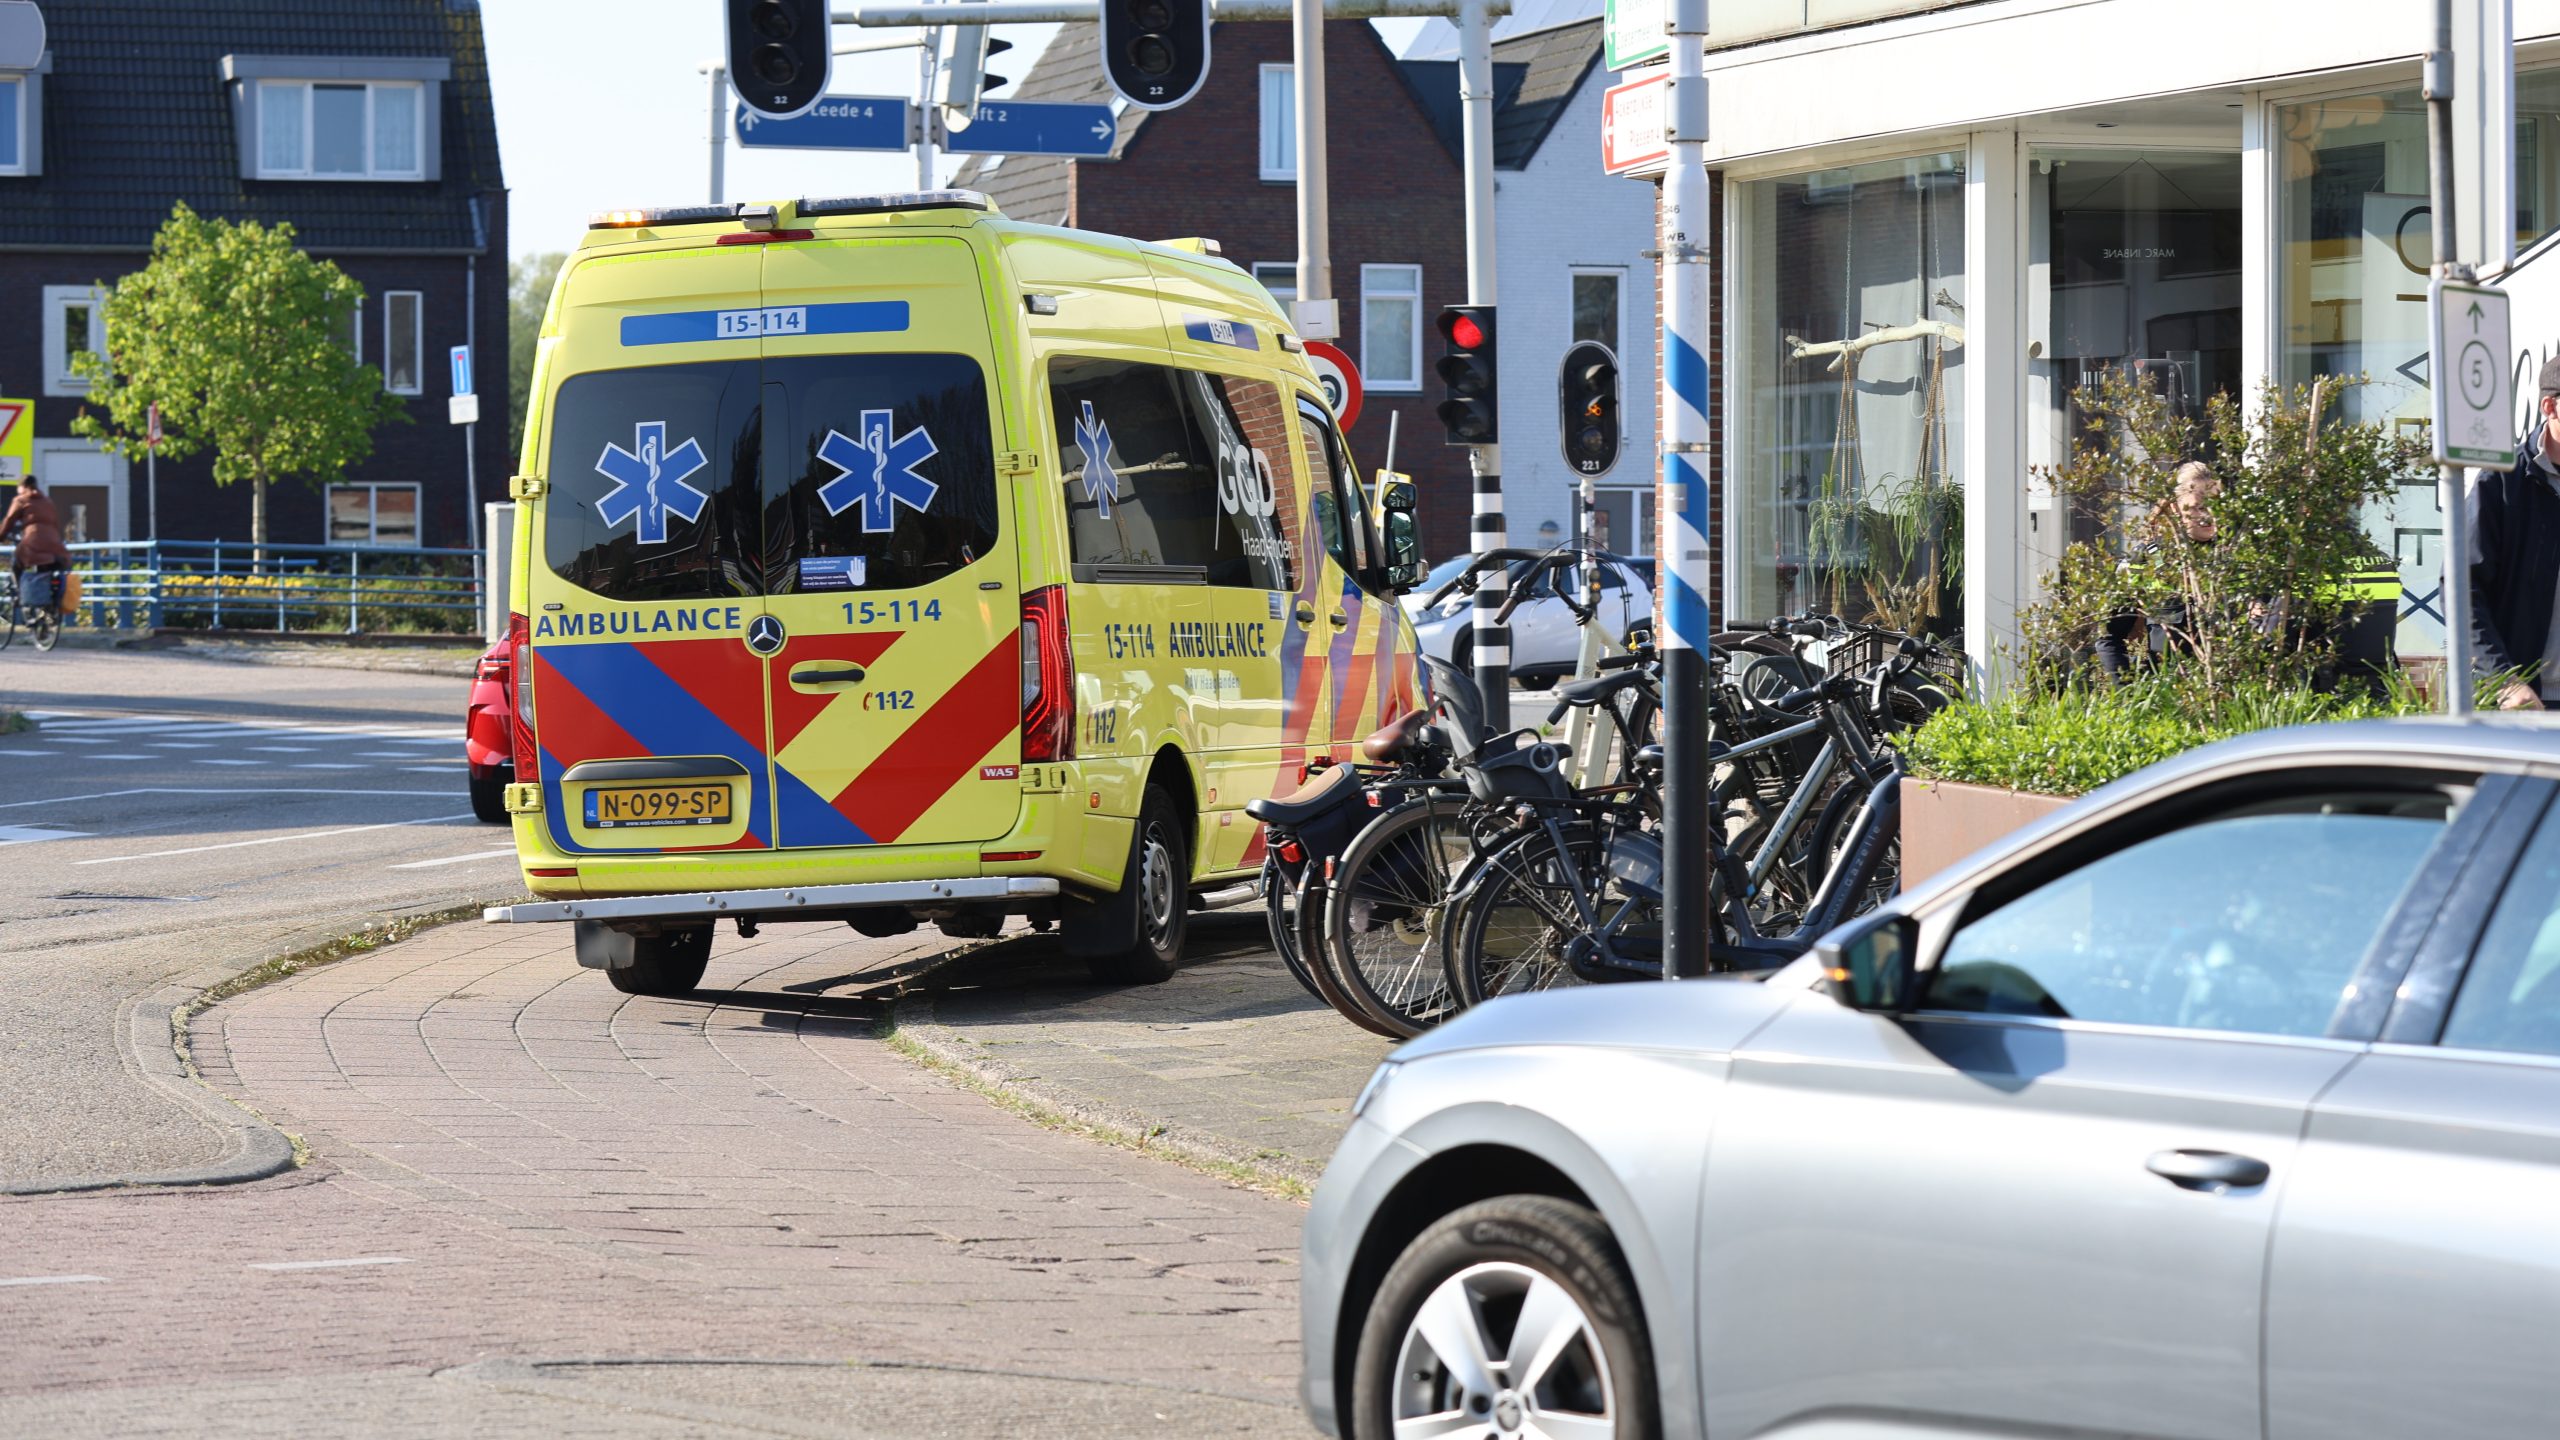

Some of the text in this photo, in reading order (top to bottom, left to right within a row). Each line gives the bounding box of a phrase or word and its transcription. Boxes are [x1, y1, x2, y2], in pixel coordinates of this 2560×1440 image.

[774, 96, 788, 104] 32
[1149, 87, 1164, 95] 22
[810, 103, 874, 118] Leede 4
[998, 109, 1007, 122] 2
[723, 311, 800, 333] 15-114
[1211, 322, 1233, 341] 15-114
[2470, 360, 2484, 389] 5
[1582, 460, 1600, 471] 22.1
[1219, 442, 1276, 517] GGD
[1241, 528, 1295, 566] Haaglanden
[535, 607, 741, 637] AMBULANCE
[842, 599, 942, 625] 15-114
[1104, 622, 1267, 659] 15-114 AMBULANCE
[984, 767, 1014, 777] WAS
[586, 790, 722, 818] NL N-099-SP
[1844, 825, 1881, 887] Gazelle
